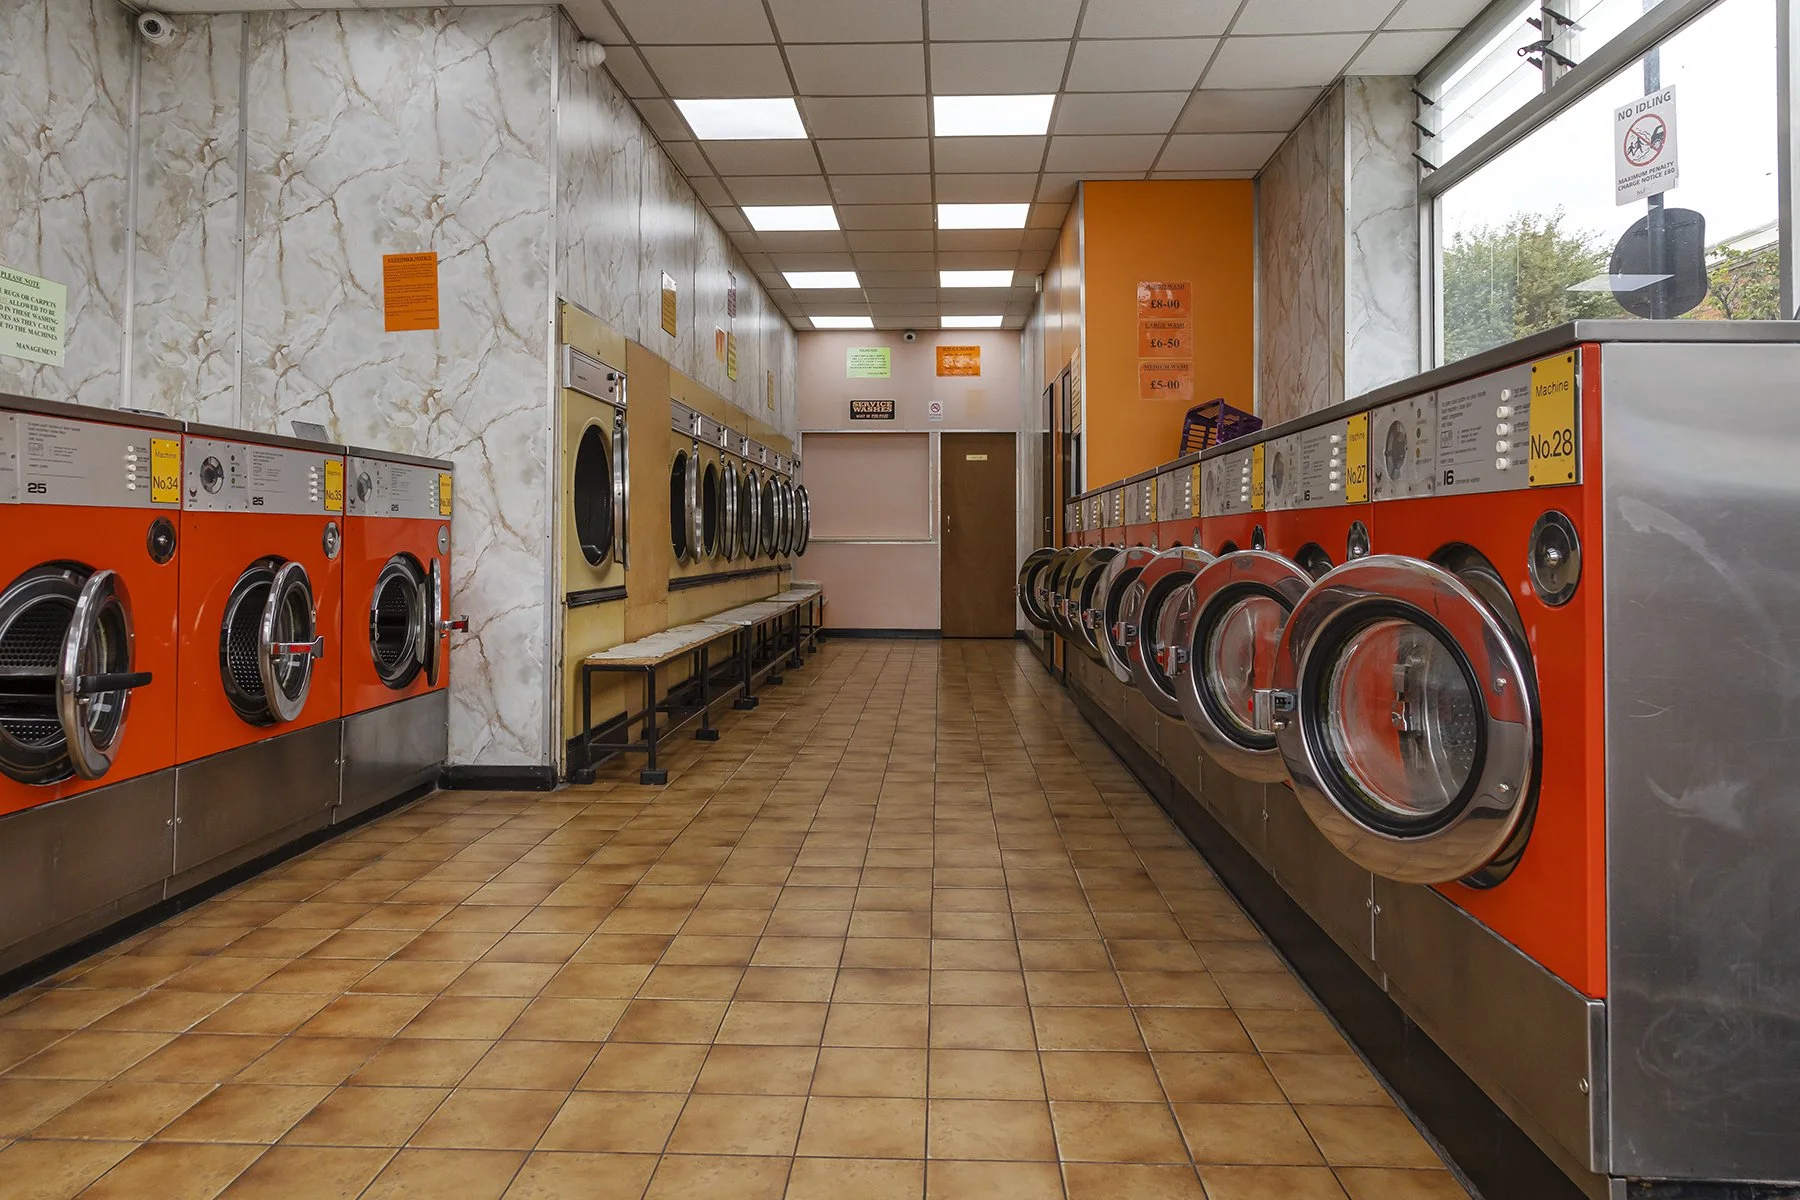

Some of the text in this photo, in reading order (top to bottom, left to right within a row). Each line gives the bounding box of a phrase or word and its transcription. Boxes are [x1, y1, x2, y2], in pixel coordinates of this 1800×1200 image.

[1617, 91, 1672, 122] NO IDLING
[1617, 167, 1676, 192] CHARGE NOTICE £80
[1618, 161, 1674, 185] MAXIMUM PENALTY
[1, 271, 39, 287] PLEASE NOTE
[4, 289, 20, 298] RUGS
[31, 296, 56, 309] CARPETS
[10, 299, 38, 311] ALLOWED
[1151, 298, 1180, 309] £8-00
[12, 307, 30, 318] THESE
[32, 313, 58, 325] WASHING
[15, 325, 26, 333] THE
[28, 328, 57, 341] MACHINES
[21, 318, 36, 327] THEY
[38, 323, 56, 332] CAUSE
[16, 341, 57, 357] MANAGEMENT
[1150, 338, 1180, 349] £6-50
[1150, 379, 1180, 390] £5-00
[1535, 380, 1569, 397] Machine
[1531, 428, 1573, 460] No.28
[153, 475, 178, 490] No.34
[1443, 469, 1454, 486] 16
[27, 482, 47, 494] 25
[252, 496, 264, 506] 25
